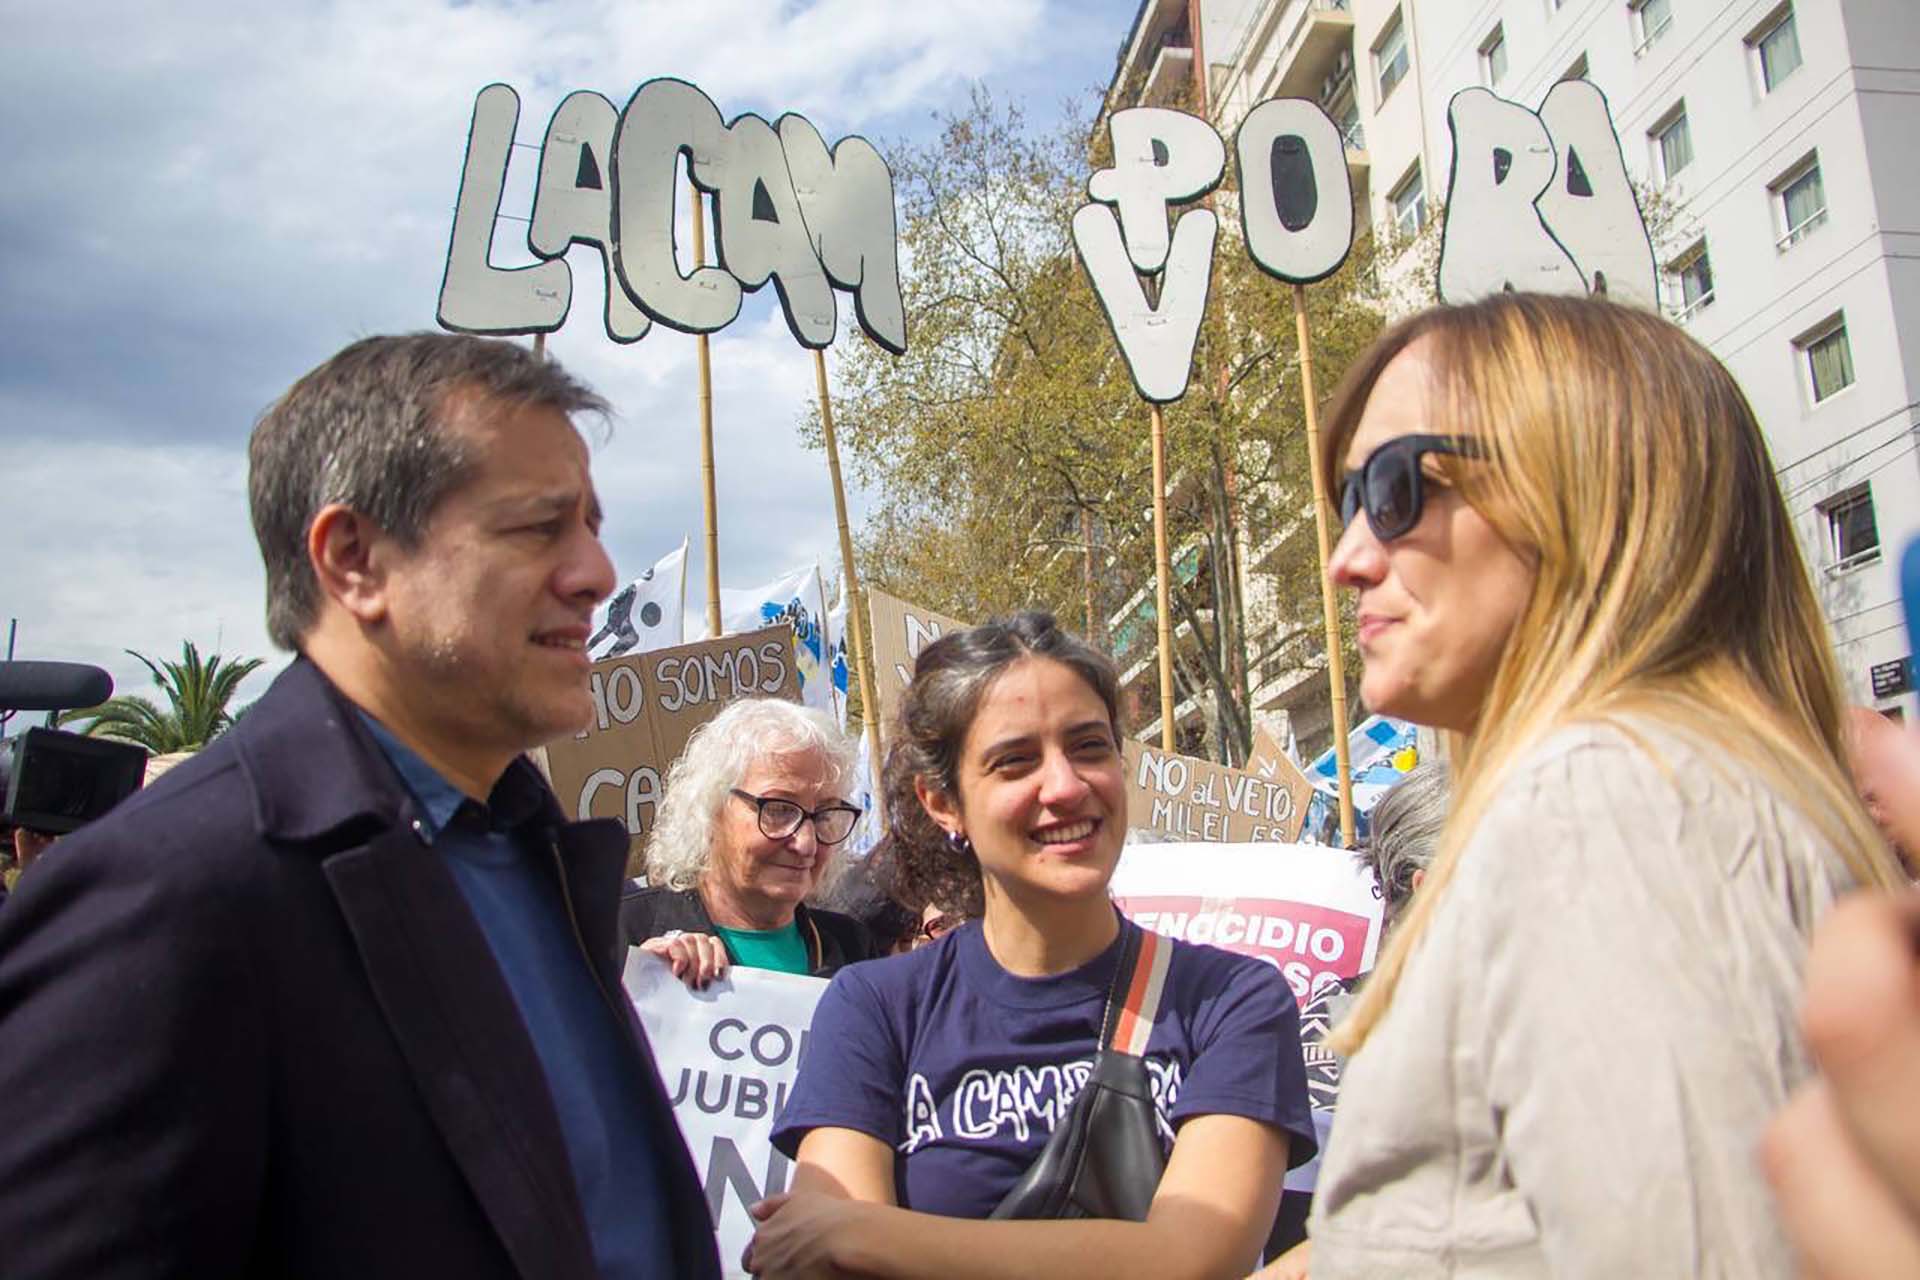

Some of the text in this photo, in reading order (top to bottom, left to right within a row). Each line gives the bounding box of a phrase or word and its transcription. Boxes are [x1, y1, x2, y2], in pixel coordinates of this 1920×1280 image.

[656, 643, 786, 712] SOMOS
[1138, 751, 1188, 796] NO
[1151, 798, 1231, 843] MILEI
[895, 1072, 944, 1153] A
